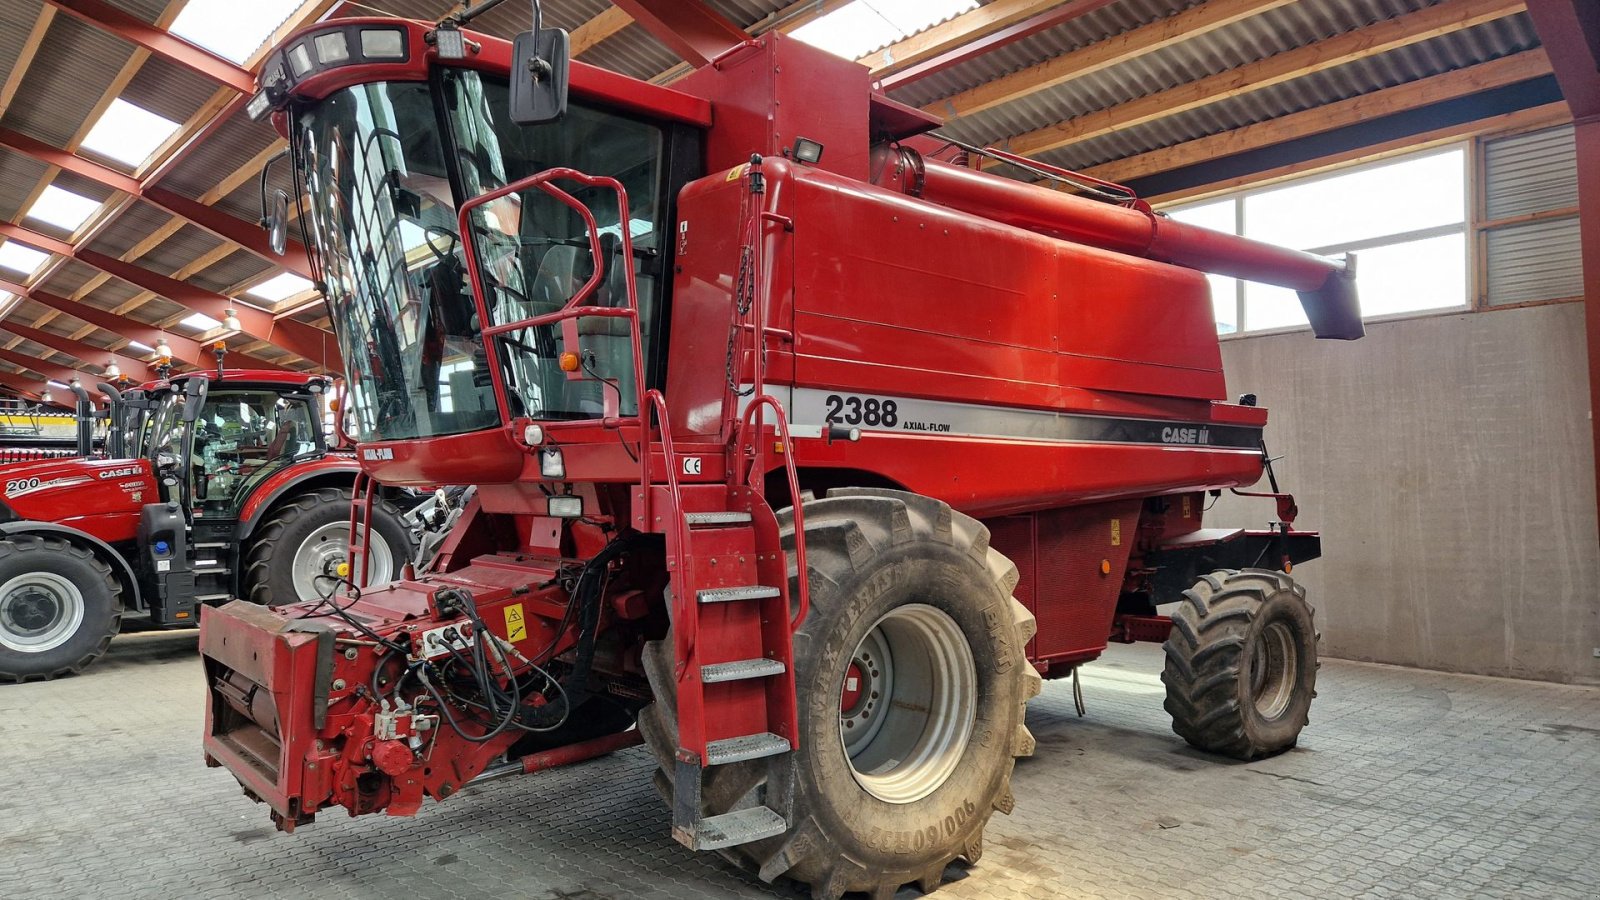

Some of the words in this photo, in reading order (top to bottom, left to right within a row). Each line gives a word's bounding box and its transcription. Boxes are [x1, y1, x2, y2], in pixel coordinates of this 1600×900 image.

[825, 394, 898, 428] 2388
[903, 421, 950, 433] AXIAL-FLOW
[1161, 426, 1197, 444] CASE
[99, 468, 132, 478] CASE
[684, 458, 700, 474] CE
[7, 478, 39, 492] 200
